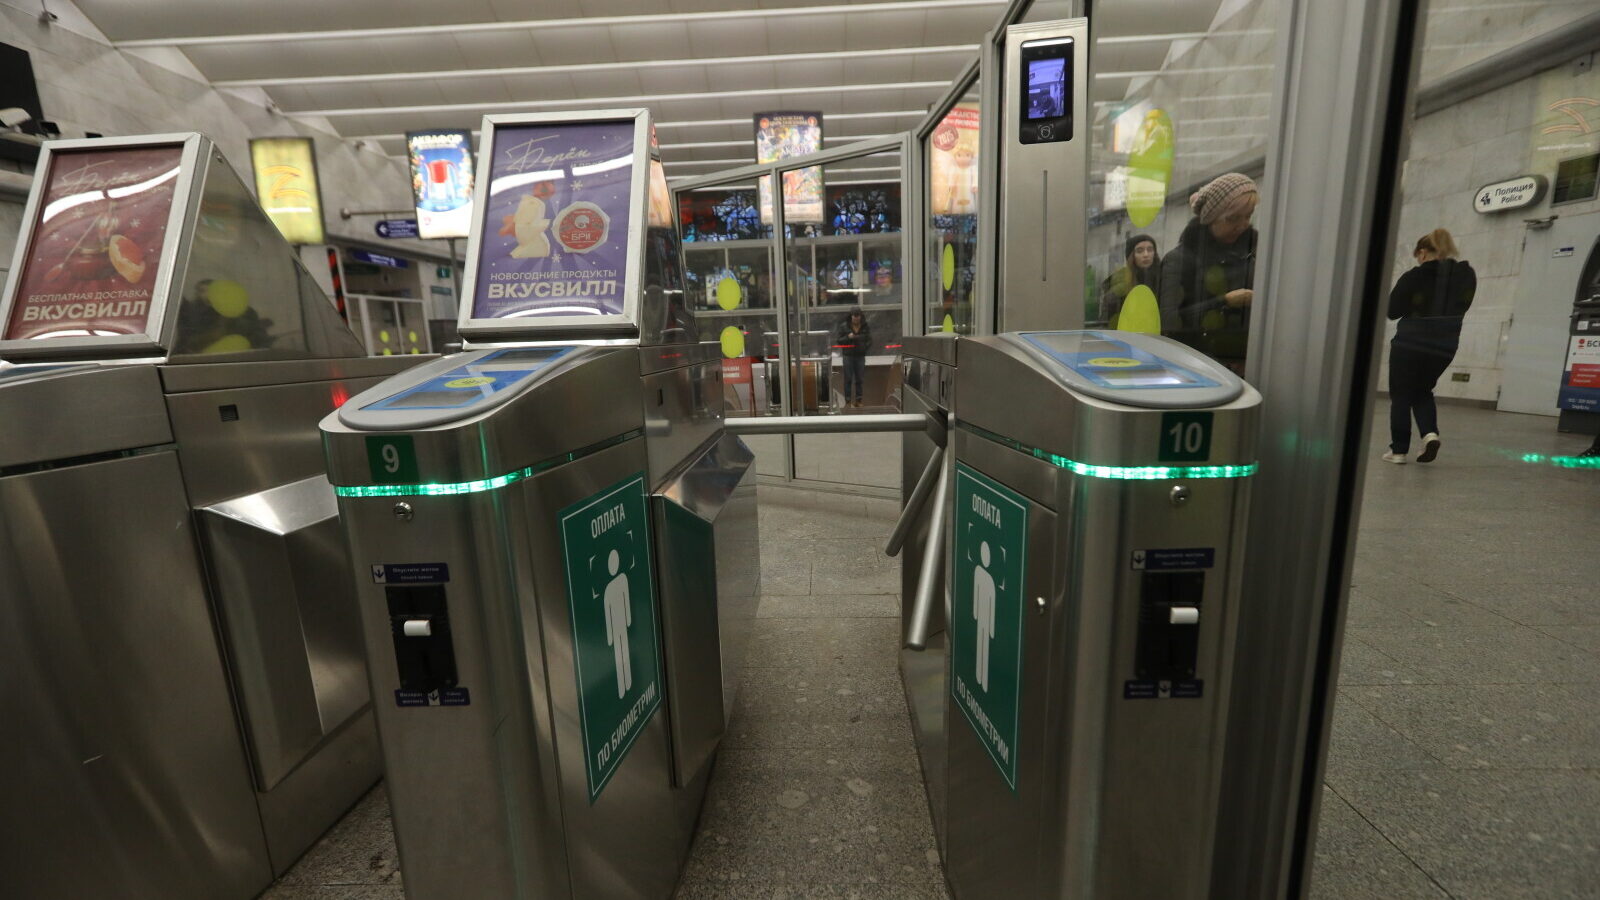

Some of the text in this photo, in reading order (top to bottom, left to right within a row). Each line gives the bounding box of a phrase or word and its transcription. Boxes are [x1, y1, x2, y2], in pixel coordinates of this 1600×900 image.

[1495, 183, 1534, 197] Полиция
[1501, 194, 1523, 204] Police
[571, 232, 591, 241] БРИ
[490, 269, 617, 281] НОВОГОДНИЕ ПРОДУКТЫ
[28, 289, 149, 303] БЕСПЛАТНАЯ ДОСТАВКА
[487, 280, 616, 298] ВКУСВИЛЛ
[23, 300, 147, 321] ВКУСВИЛЛ
[1169, 421, 1203, 455] 10
[382, 444, 400, 473] 9
[591, 503, 626, 539] ОПЛАТА
[971, 493, 1001, 529] ОПЛАТА
[597, 681, 656, 771] ПО БИОМЕТРИИ
[957, 675, 1009, 765] ПО БИОМЕТРИИ
